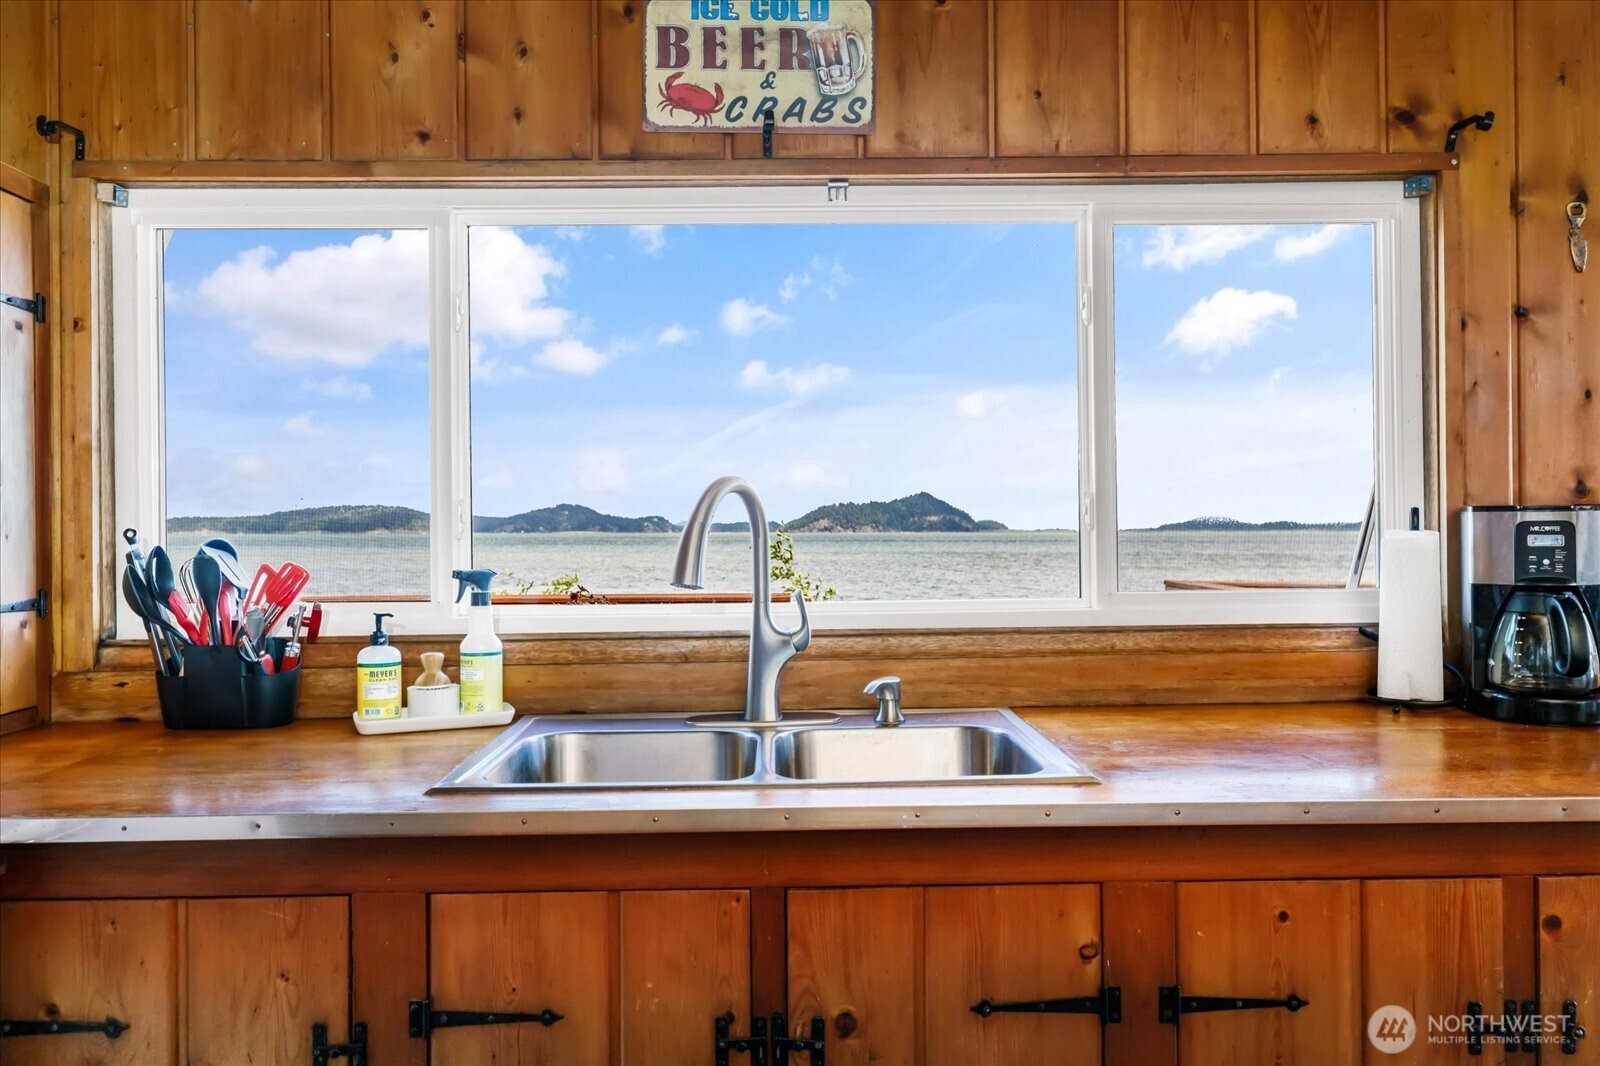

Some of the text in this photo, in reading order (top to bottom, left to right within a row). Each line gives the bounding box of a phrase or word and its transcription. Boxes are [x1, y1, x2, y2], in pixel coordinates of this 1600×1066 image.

[691, 0, 829, 21] ICE COLD
[656, 26, 814, 71] BEER
[760, 71, 777, 90] &
[725, 96, 867, 124] CRABS
[369, 669, 397, 678] MEYER'S
